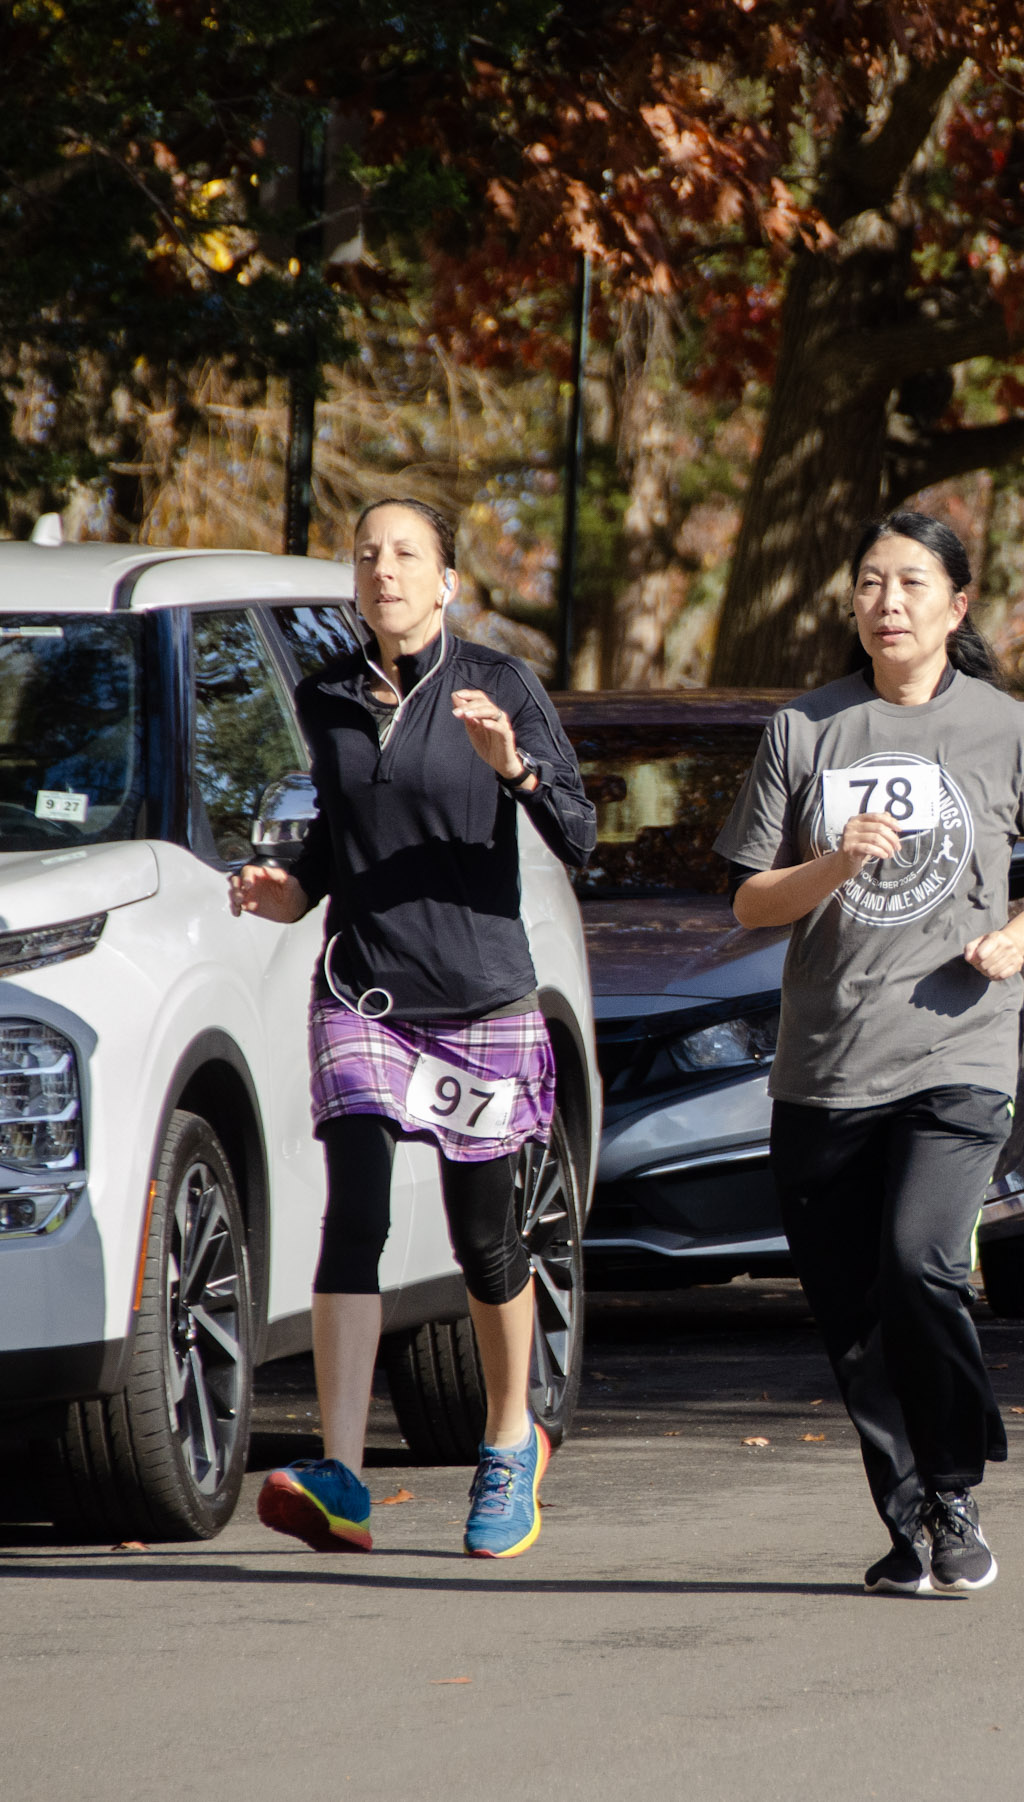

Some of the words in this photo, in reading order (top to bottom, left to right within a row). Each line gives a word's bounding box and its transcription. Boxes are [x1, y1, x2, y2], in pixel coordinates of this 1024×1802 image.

[46, 799, 55, 810] 9
[64, 801, 80, 812] 27
[849, 777, 914, 821] 78
[860, 891, 885, 911] AND
[885, 891, 913, 911] MILE
[912, 869, 946, 902] WALK
[429, 1076, 496, 1128] 97
